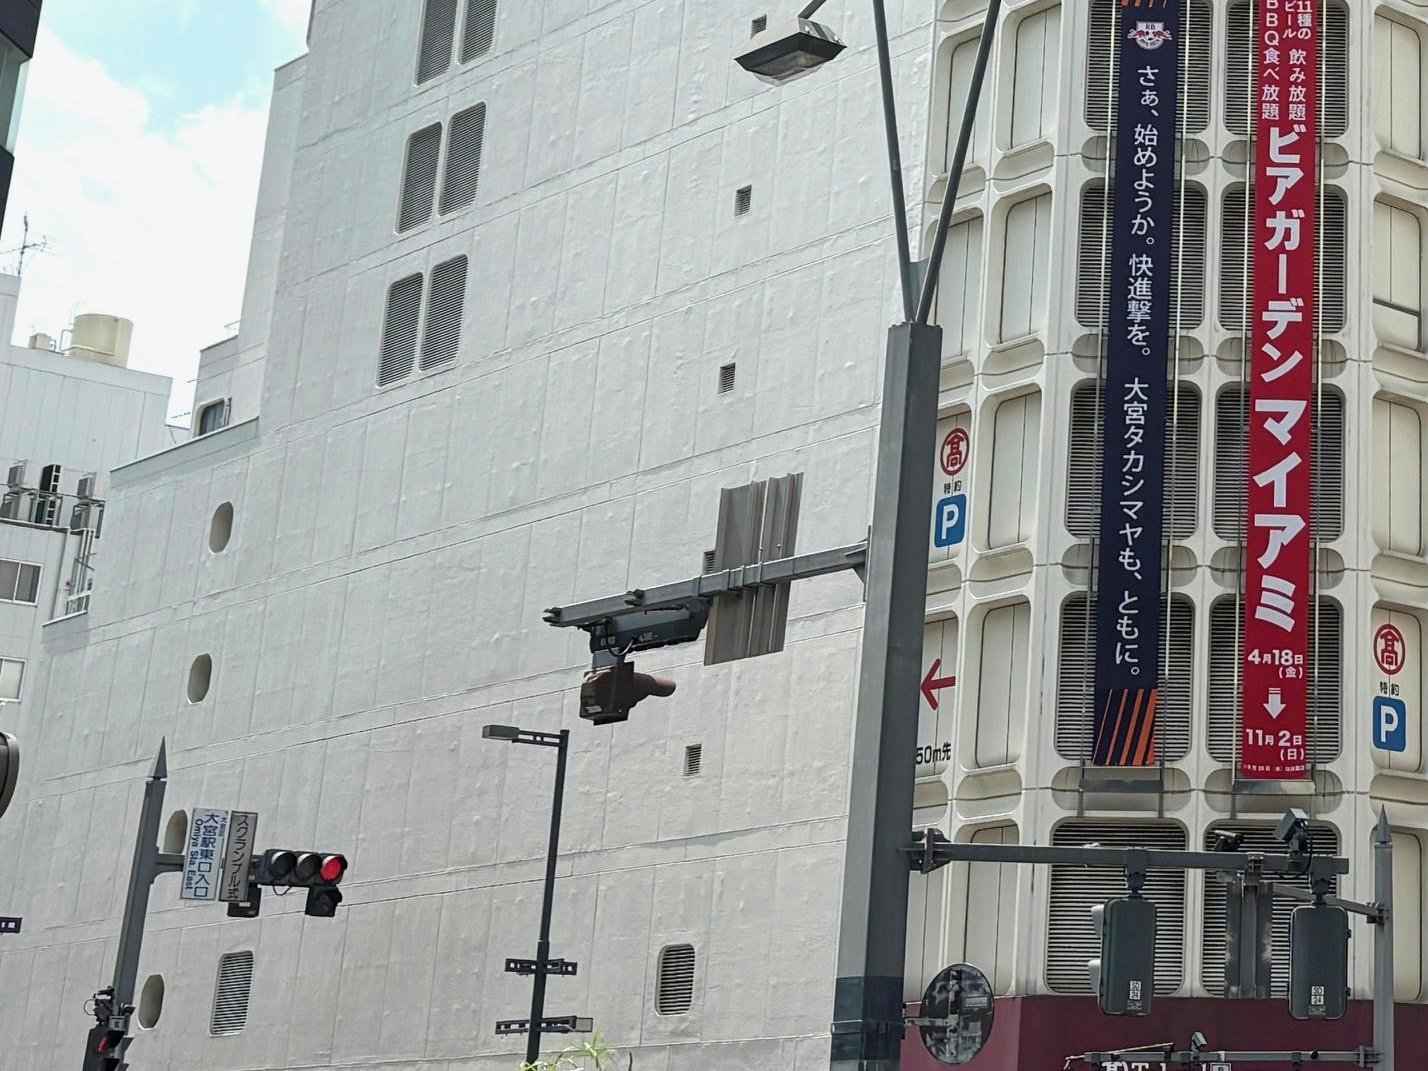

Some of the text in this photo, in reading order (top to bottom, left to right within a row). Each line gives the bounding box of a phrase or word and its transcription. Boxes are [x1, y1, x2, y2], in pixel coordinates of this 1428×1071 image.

[1247, 648, 1303, 666] 4月18日
[1379, 680, 1400, 696] 特約
[1380, 705, 1399, 743] P
[191, 818, 203, 848] Omiya
[193, 812, 220, 898] 大宮駅東口入口
[185, 869, 196, 890] East
